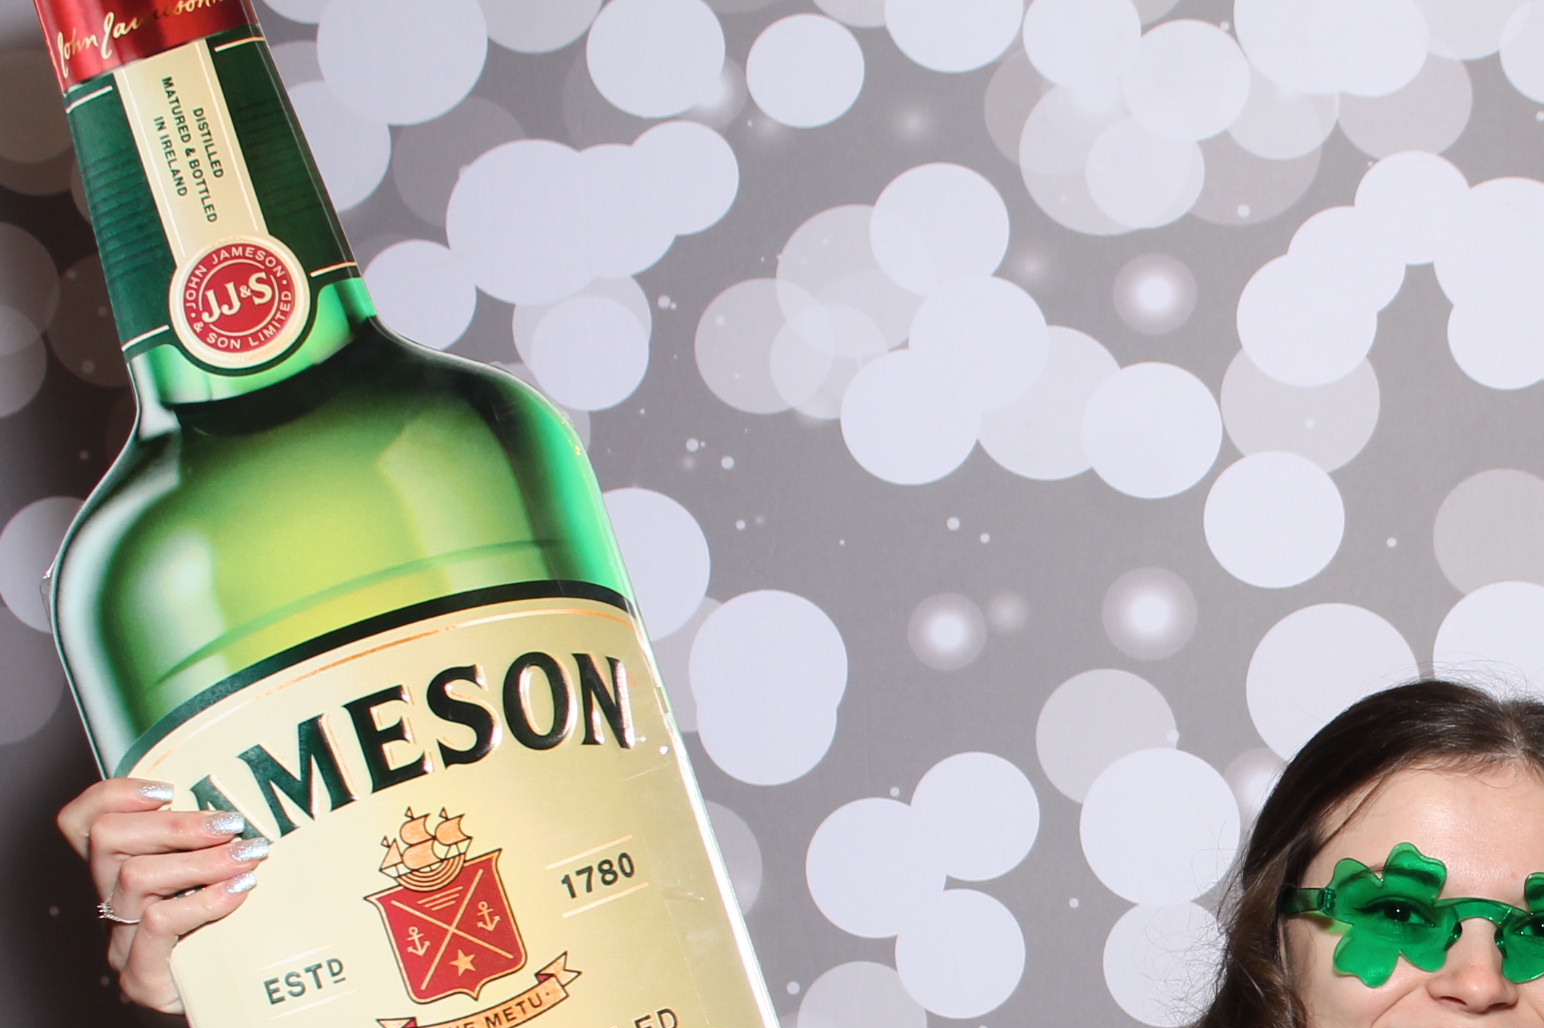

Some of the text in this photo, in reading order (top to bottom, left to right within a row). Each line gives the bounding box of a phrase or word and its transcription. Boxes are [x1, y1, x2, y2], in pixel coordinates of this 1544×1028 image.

[153, 116, 188, 197] IN IRELAND
[161, 76, 218, 223] MATURED & BOTTLED
[193, 107, 224, 179] DISTILLED
[185, 246, 286, 309] JOHN JAMESON
[202, 271, 273, 323] JJ&S
[193, 290, 292, 349] & SON LIMITED
[190, 651, 636, 844] AMESON
[561, 852, 636, 900] 1780
